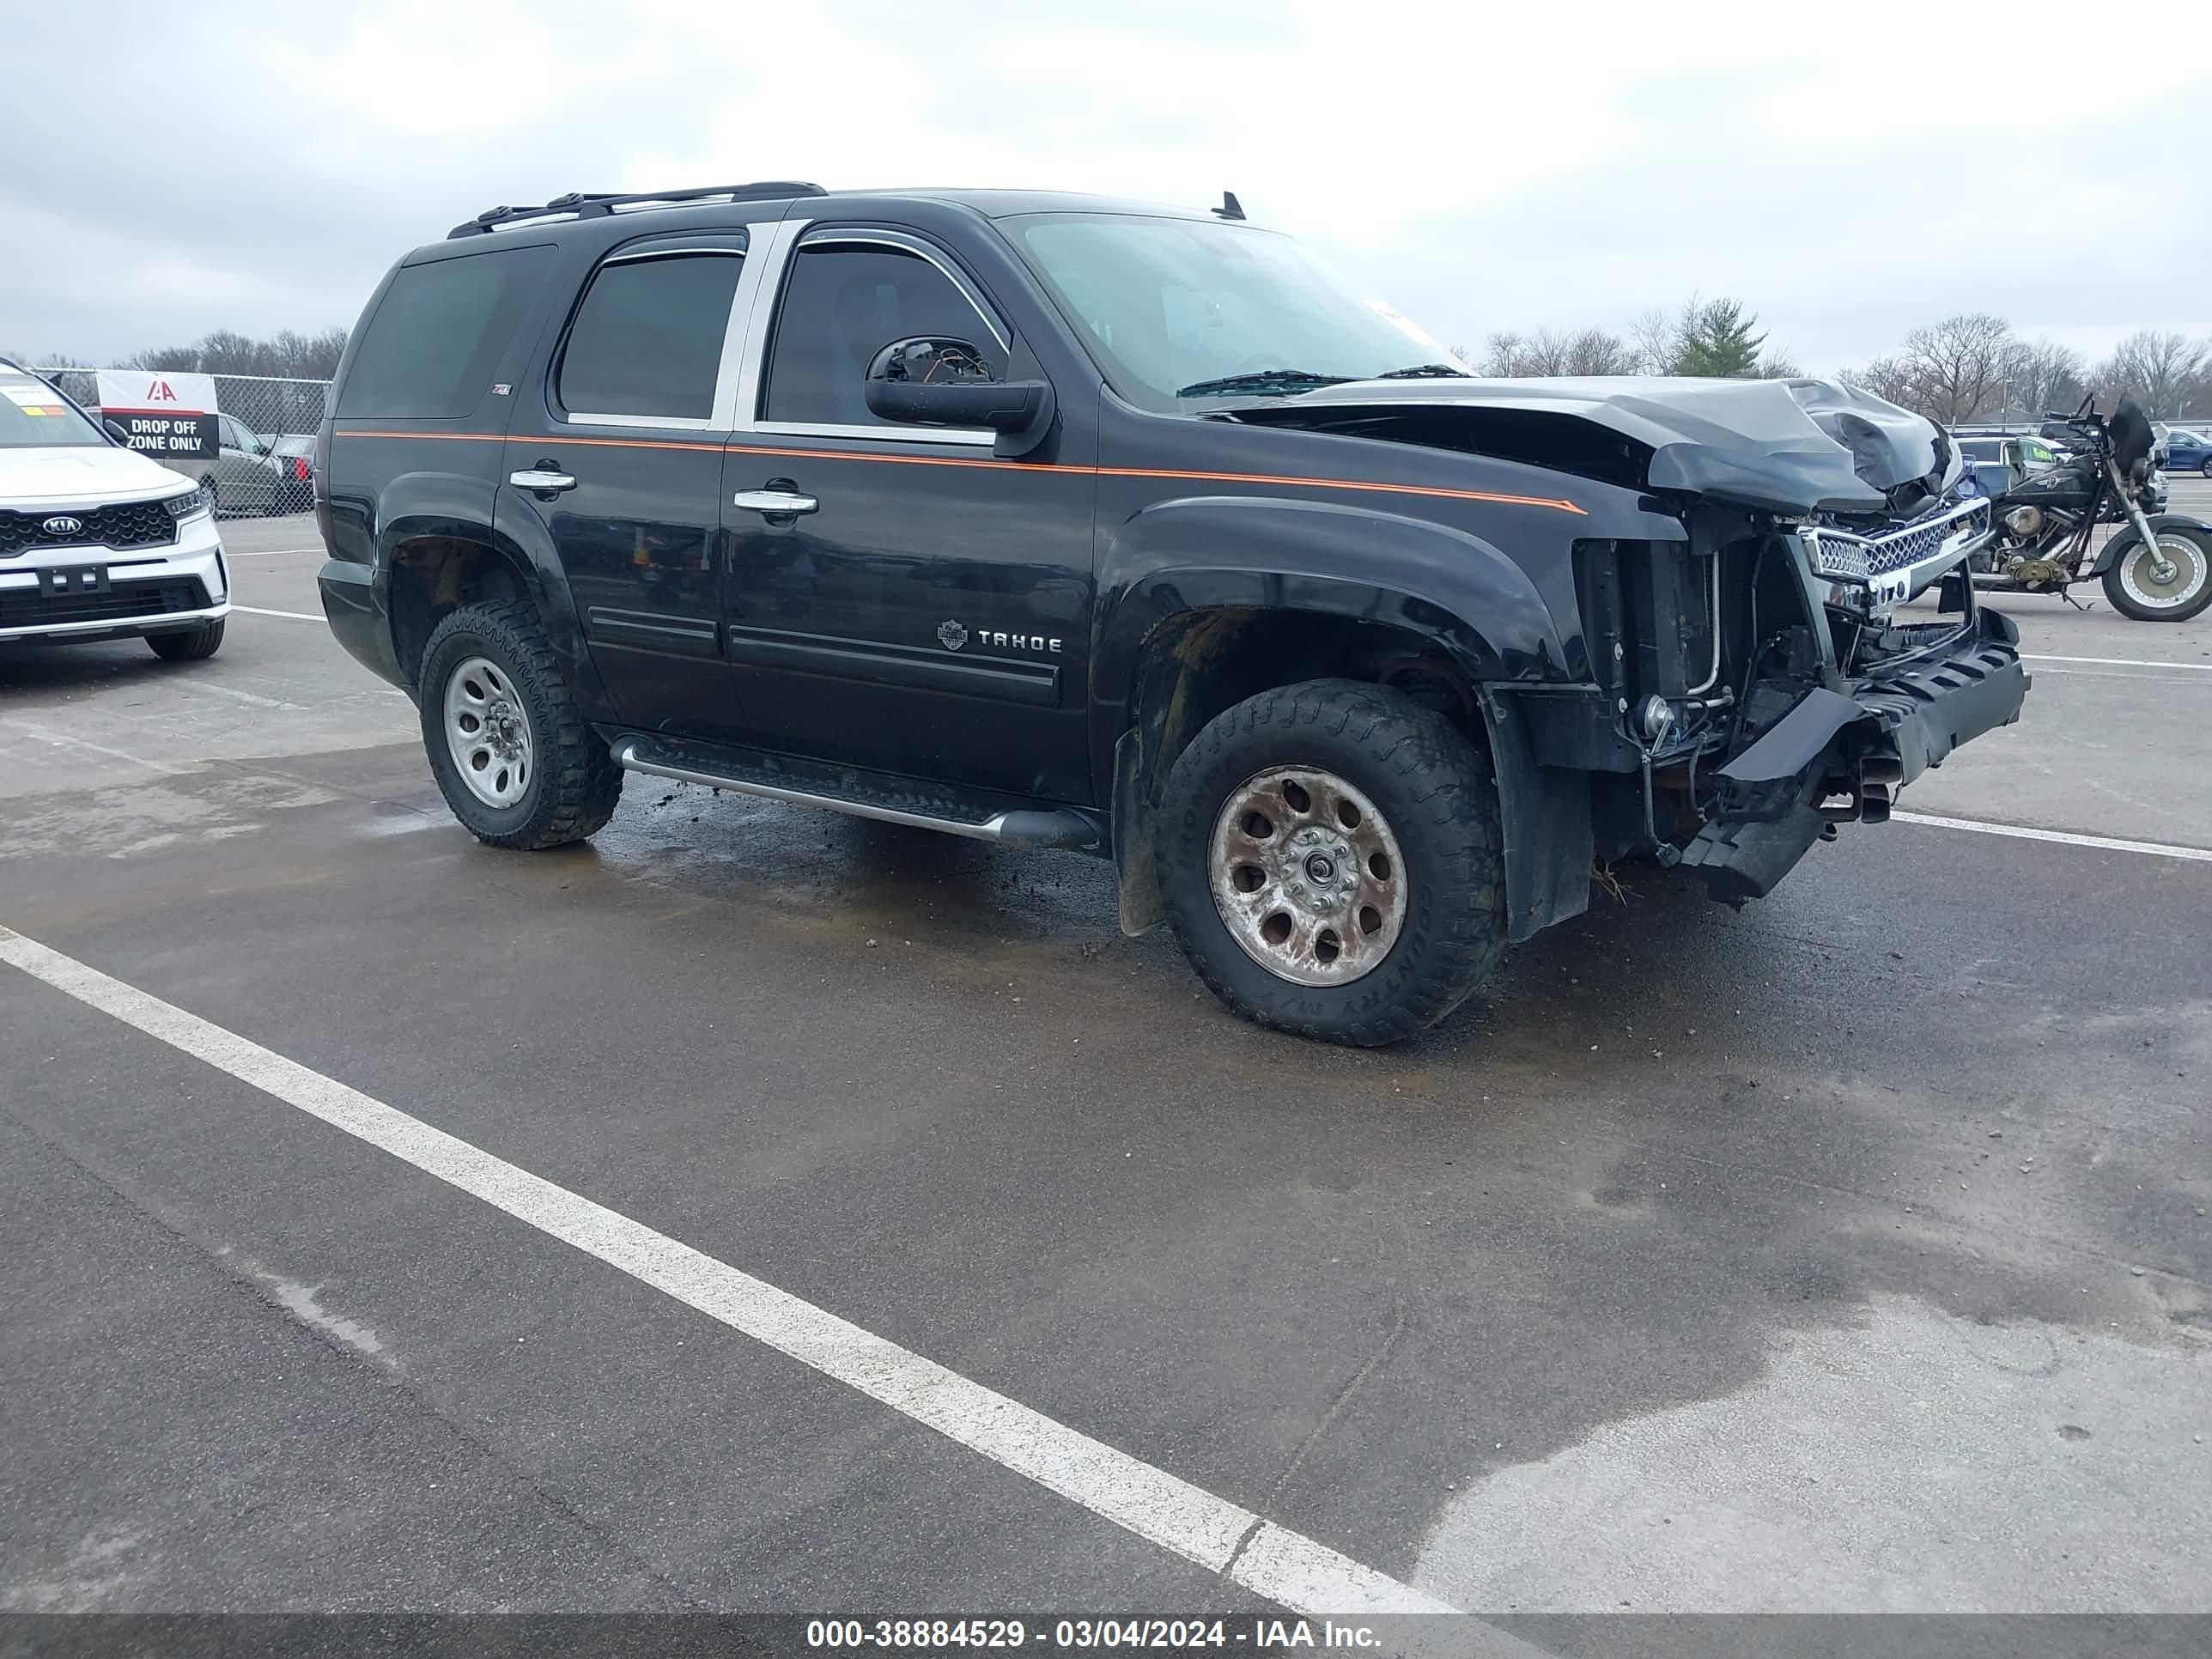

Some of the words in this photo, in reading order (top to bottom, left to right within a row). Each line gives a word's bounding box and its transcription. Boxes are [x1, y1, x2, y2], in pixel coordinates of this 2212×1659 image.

[131, 419, 171, 434] DROP
[173, 420, 198, 434] OFF
[126, 435, 167, 449] ZONE
[169, 436, 203, 451] ONLY
[978, 630, 1062, 653] TAHOE
[1340, 882, 1433, 1017] COUNTRY
